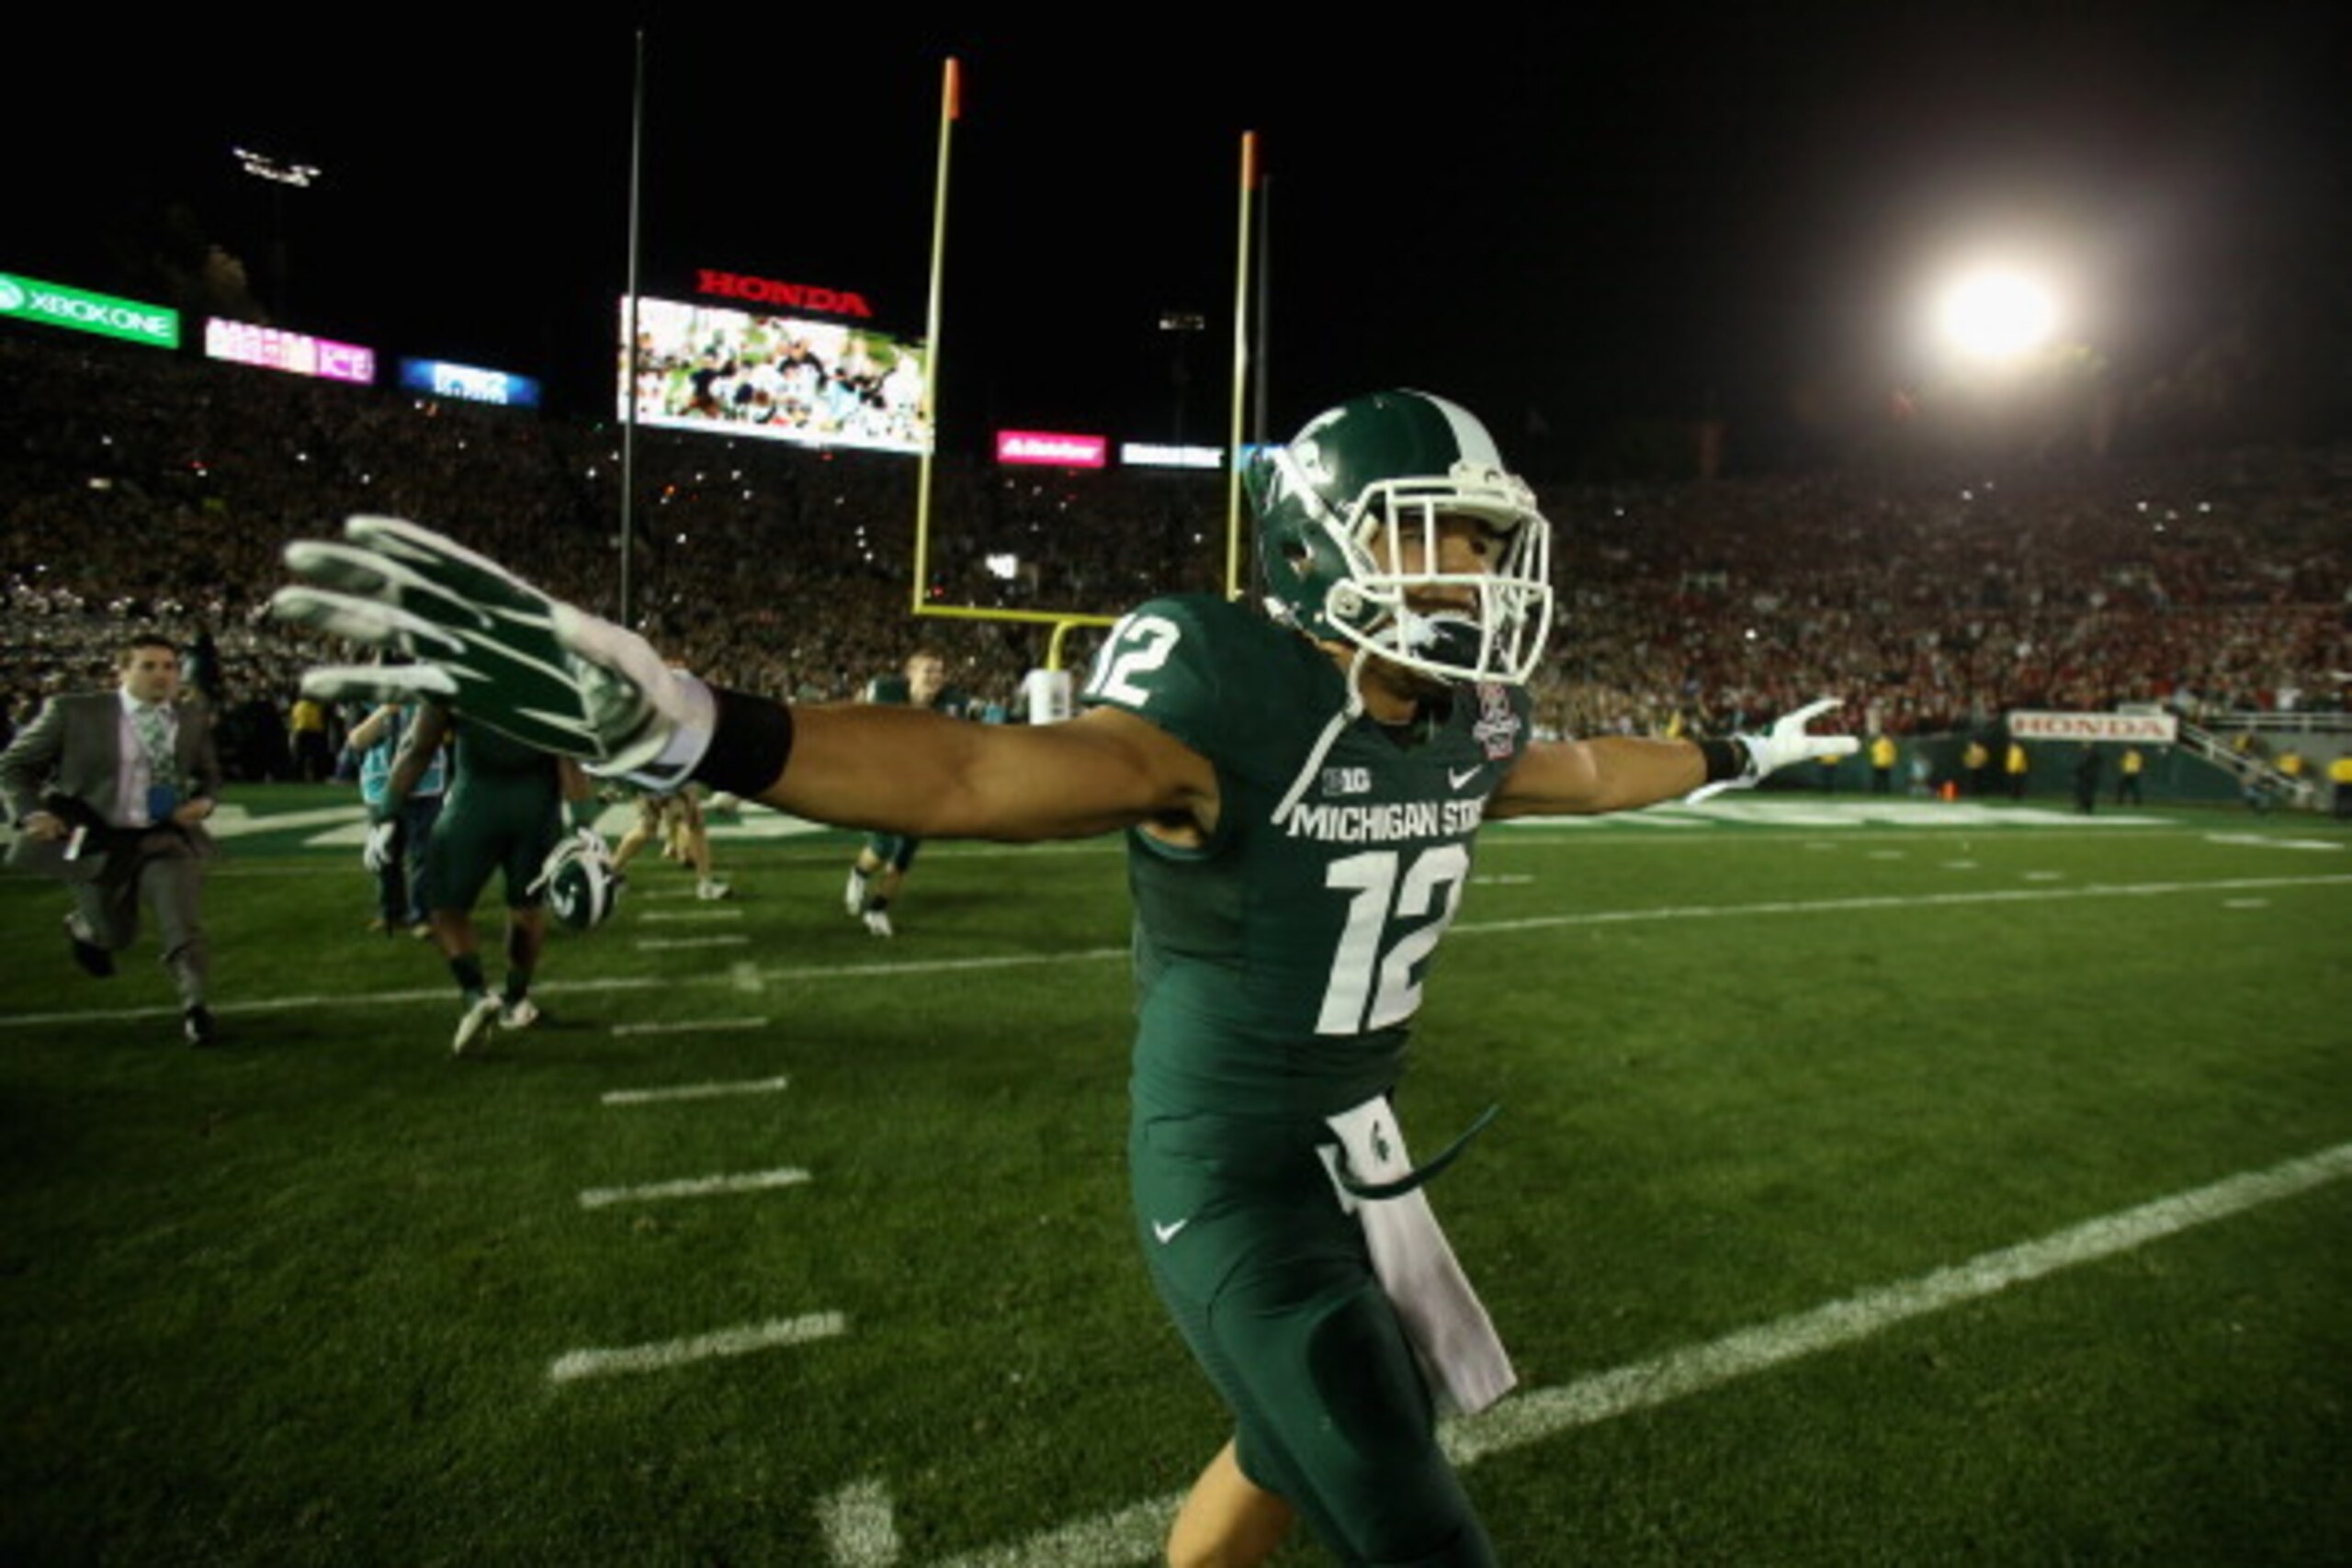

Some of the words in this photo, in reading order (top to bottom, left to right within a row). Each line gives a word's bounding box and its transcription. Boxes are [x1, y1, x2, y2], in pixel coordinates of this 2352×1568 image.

[695, 268, 874, 318] HONDA
[110, 309, 173, 338] ONE
[1084, 612, 1182, 708] 12
[2014, 716, 2166, 736] HONDA
[1286, 801, 1439, 842] MICHIGAN
[1314, 842, 1470, 1035] 12
